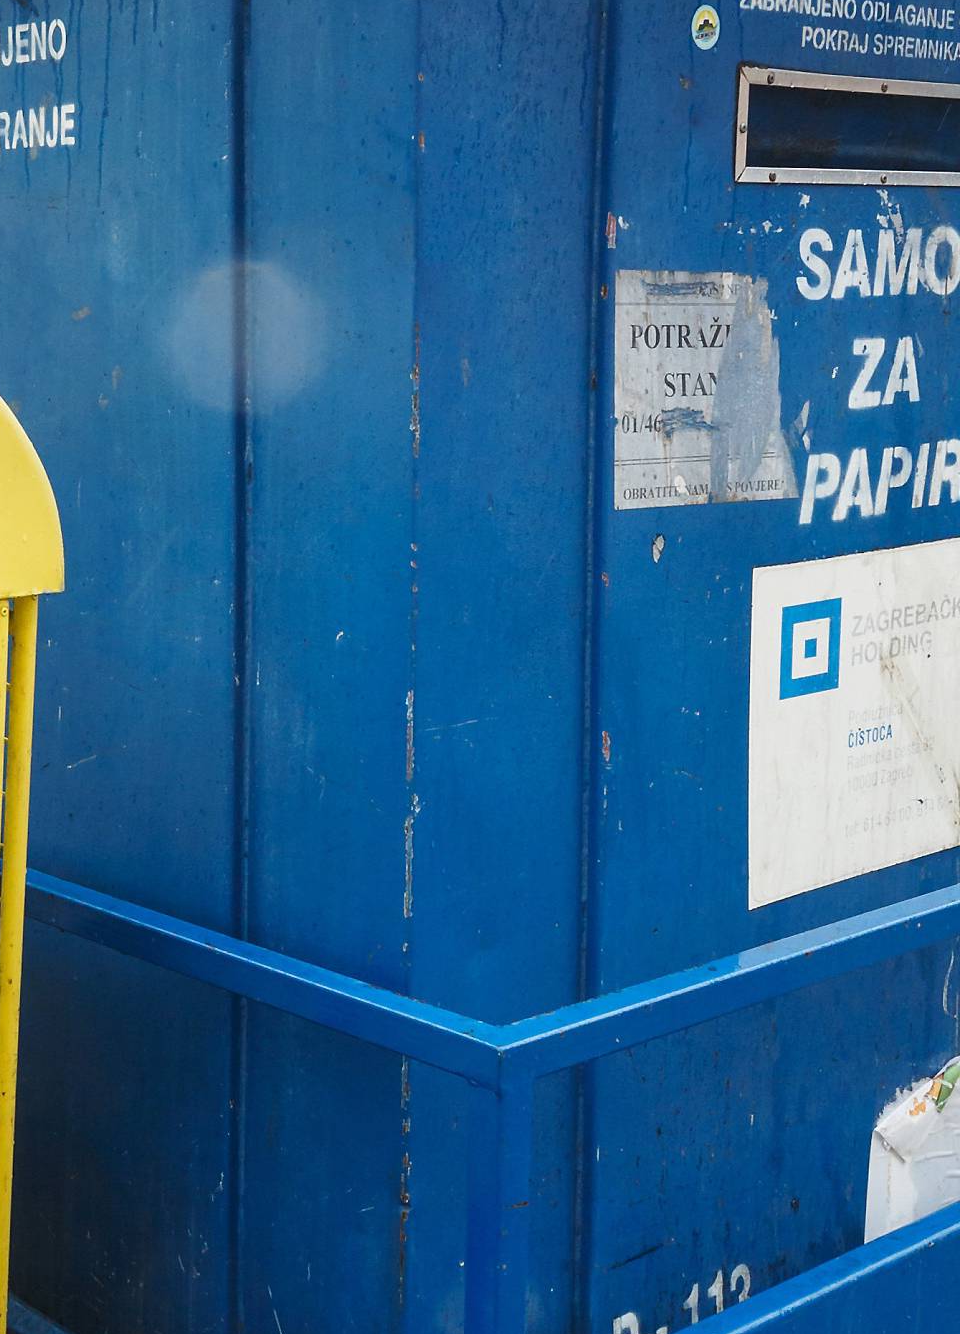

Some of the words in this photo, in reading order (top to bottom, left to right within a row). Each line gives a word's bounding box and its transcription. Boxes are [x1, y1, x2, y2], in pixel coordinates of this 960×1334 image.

[801, 25, 868, 54] POKRAJ
[861, 0, 955, 30] ODLAGANJE
[796, 226, 960, 301] SAMO
[848, 336, 921, 410] ZA
[798, 438, 960, 525] PAPIR
[851, 630, 933, 667] HOLDING
